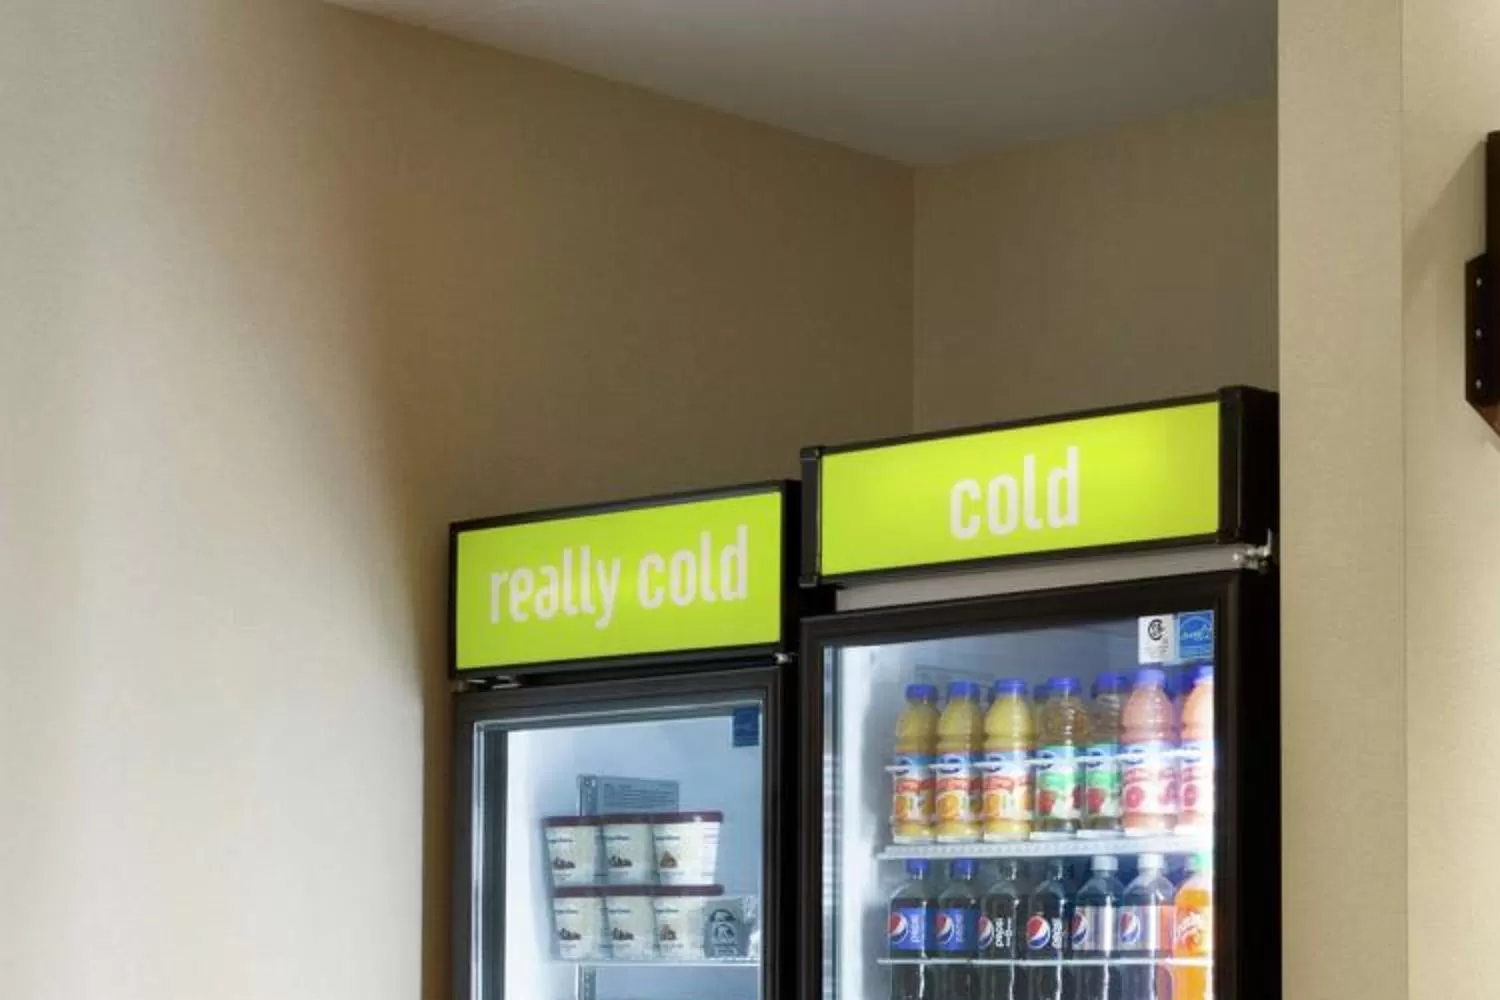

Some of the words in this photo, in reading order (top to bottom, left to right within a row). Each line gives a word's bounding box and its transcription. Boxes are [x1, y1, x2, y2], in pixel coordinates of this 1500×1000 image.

[950, 446, 1080, 540] cold
[489, 545, 620, 630] really
[637, 523, 749, 610] cold
